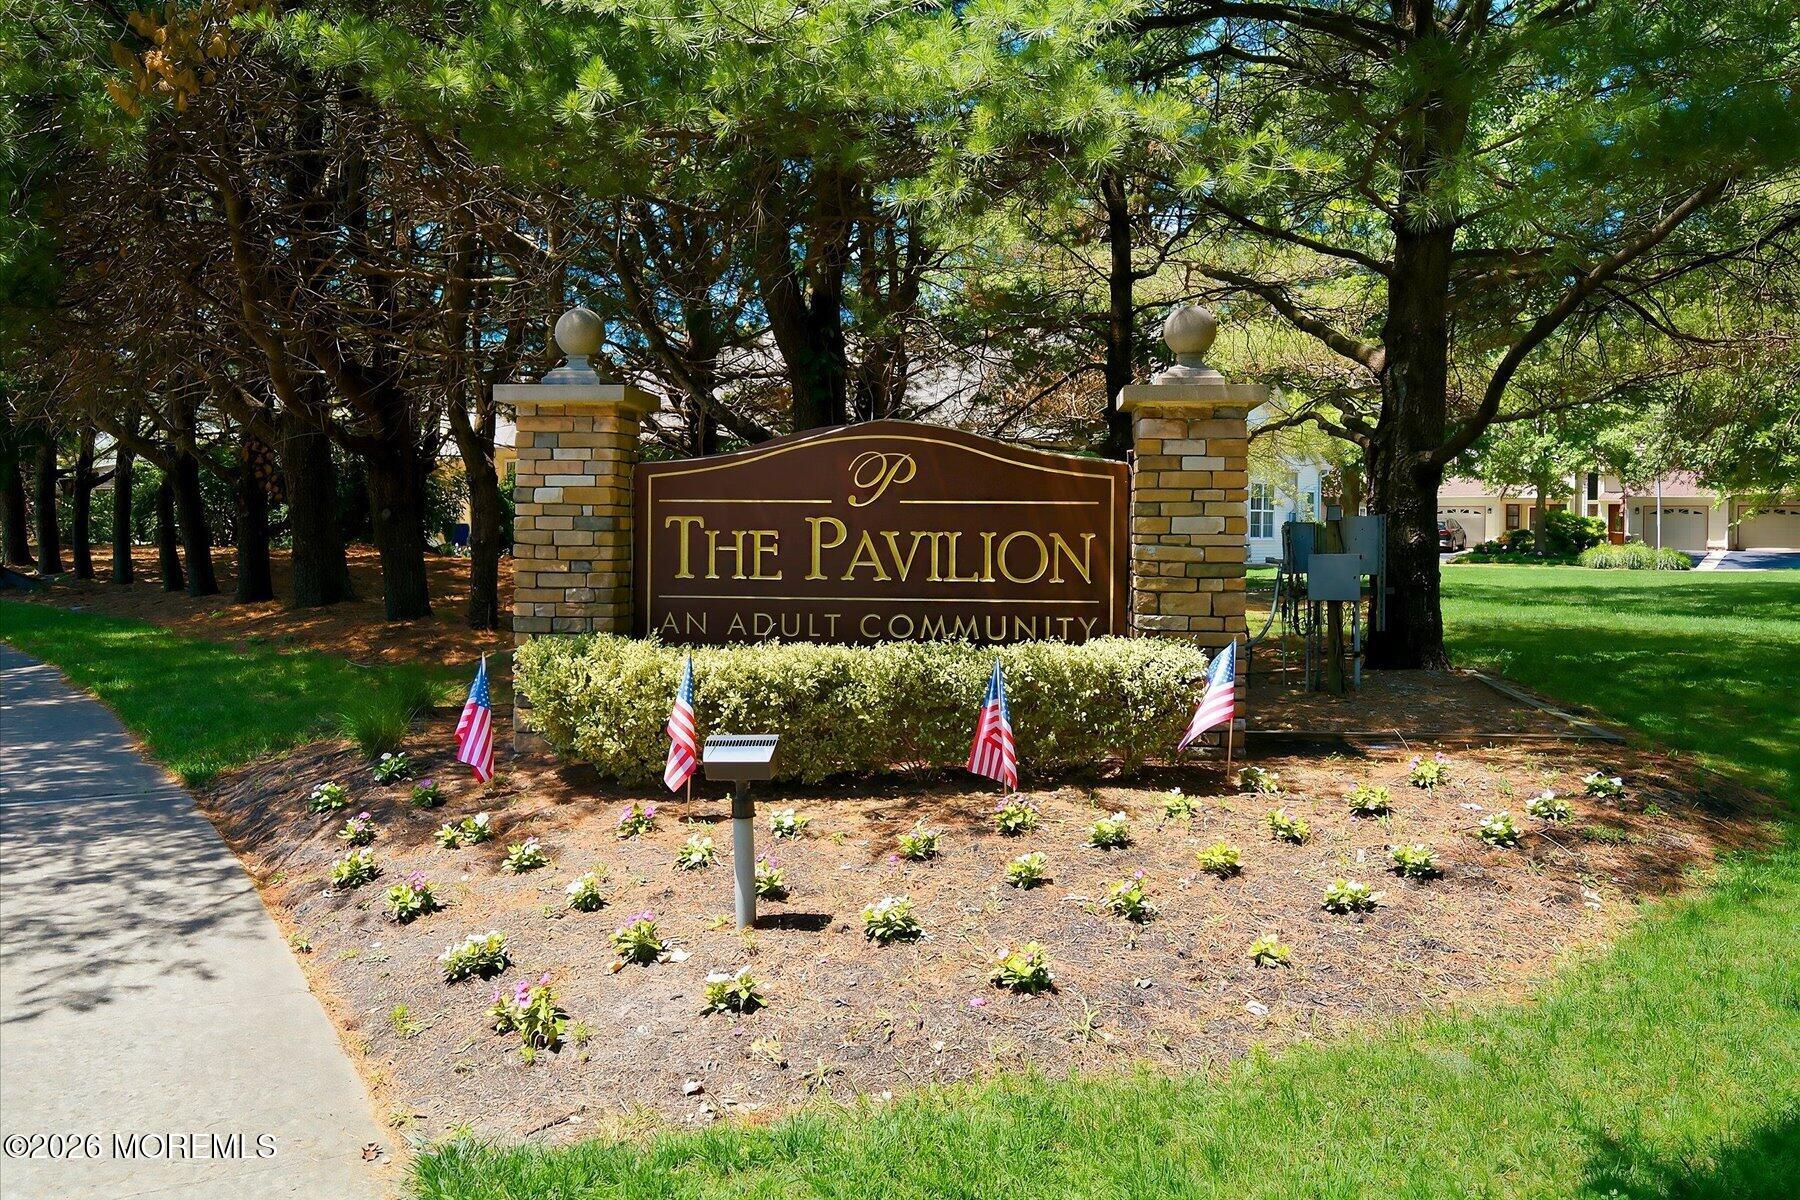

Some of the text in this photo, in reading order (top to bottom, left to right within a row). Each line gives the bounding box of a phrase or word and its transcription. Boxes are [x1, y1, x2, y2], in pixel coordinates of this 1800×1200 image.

[847, 451, 917, 508] P
[660, 611, 1099, 642] AN ADULT COMMUNITY
